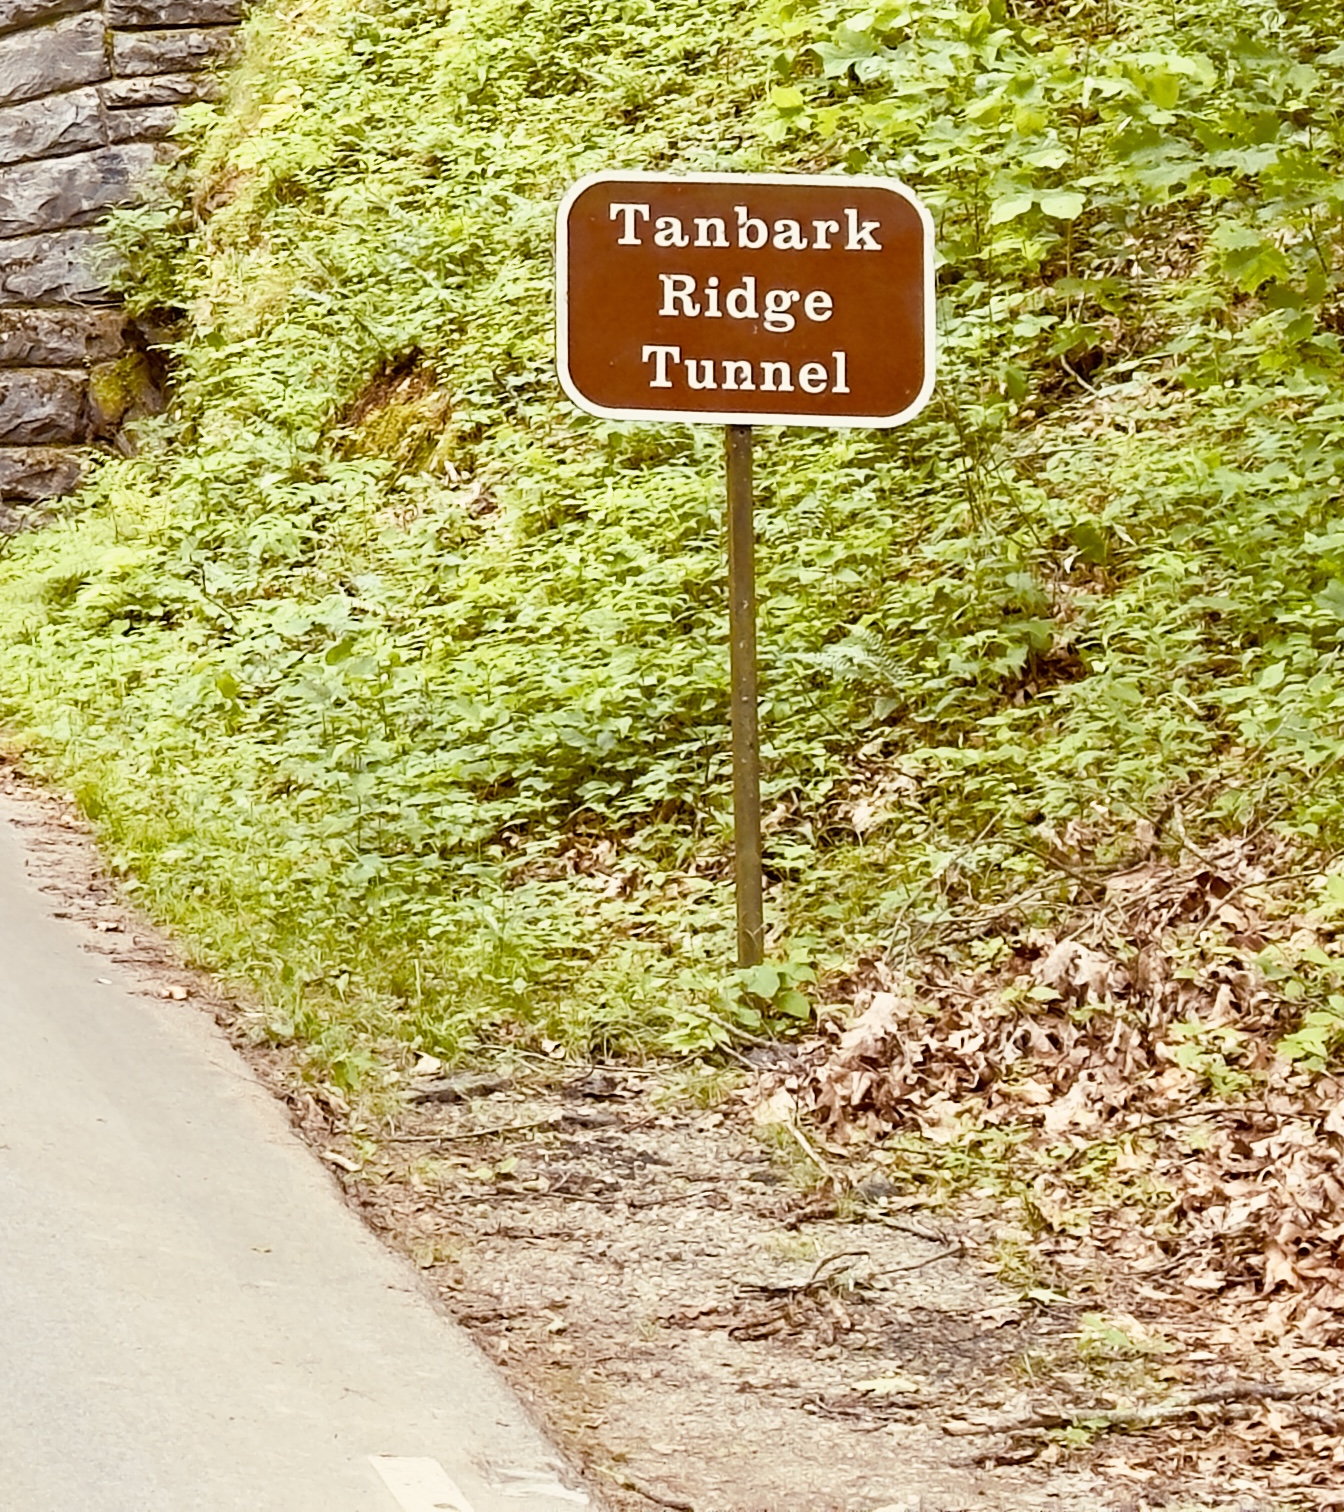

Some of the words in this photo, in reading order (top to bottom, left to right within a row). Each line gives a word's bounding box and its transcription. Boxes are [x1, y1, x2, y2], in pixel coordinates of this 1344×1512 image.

[609, 203, 882, 251] Tanbark
[658, 273, 833, 333] Ridge
[641, 345, 851, 395] Tunnel
